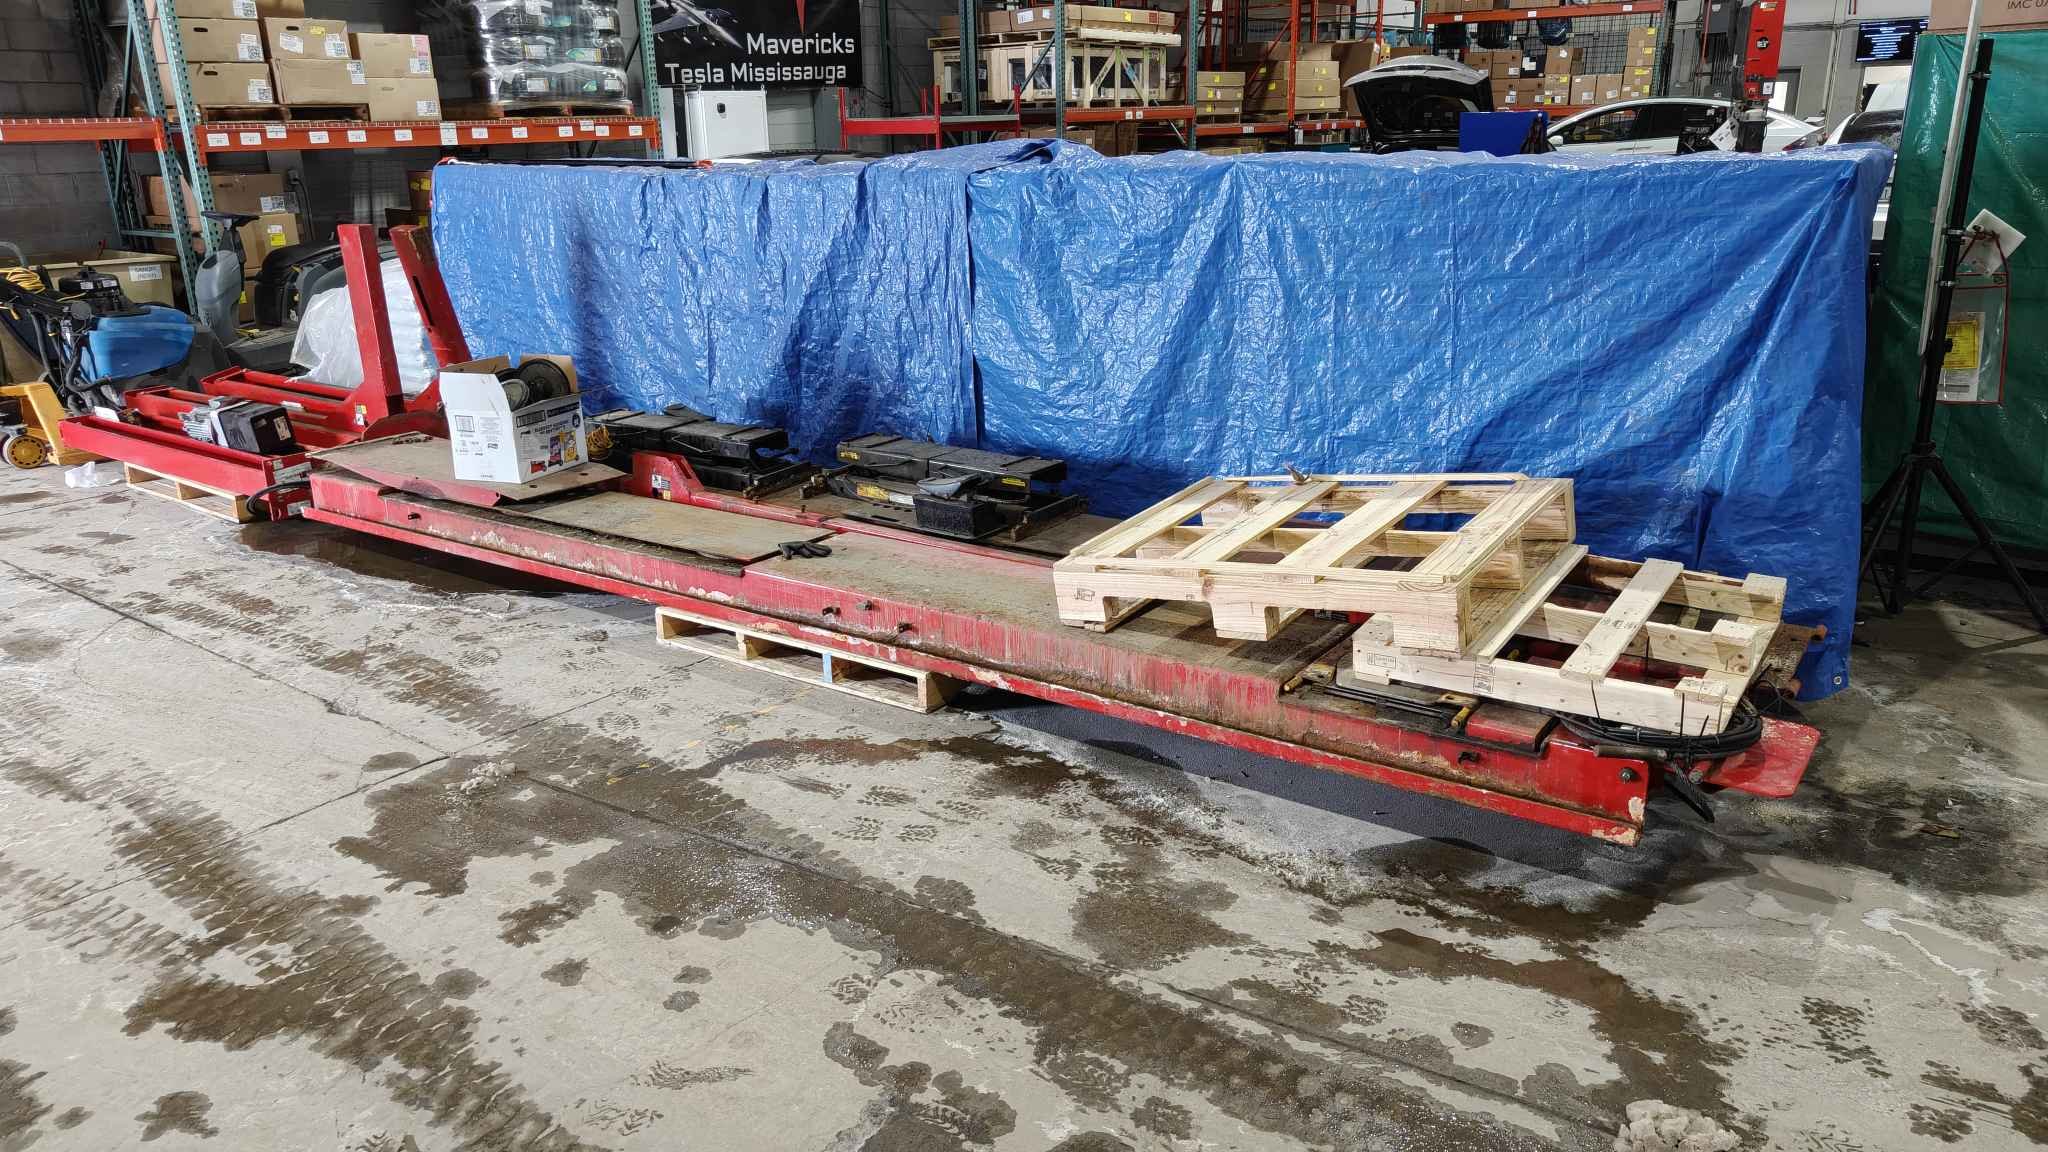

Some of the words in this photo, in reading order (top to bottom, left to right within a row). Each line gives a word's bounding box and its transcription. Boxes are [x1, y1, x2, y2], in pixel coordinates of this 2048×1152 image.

[746, 32, 855, 54] Mavericks
[664, 62, 724, 84] Tesla
[731, 62, 847, 84] Mississauga
